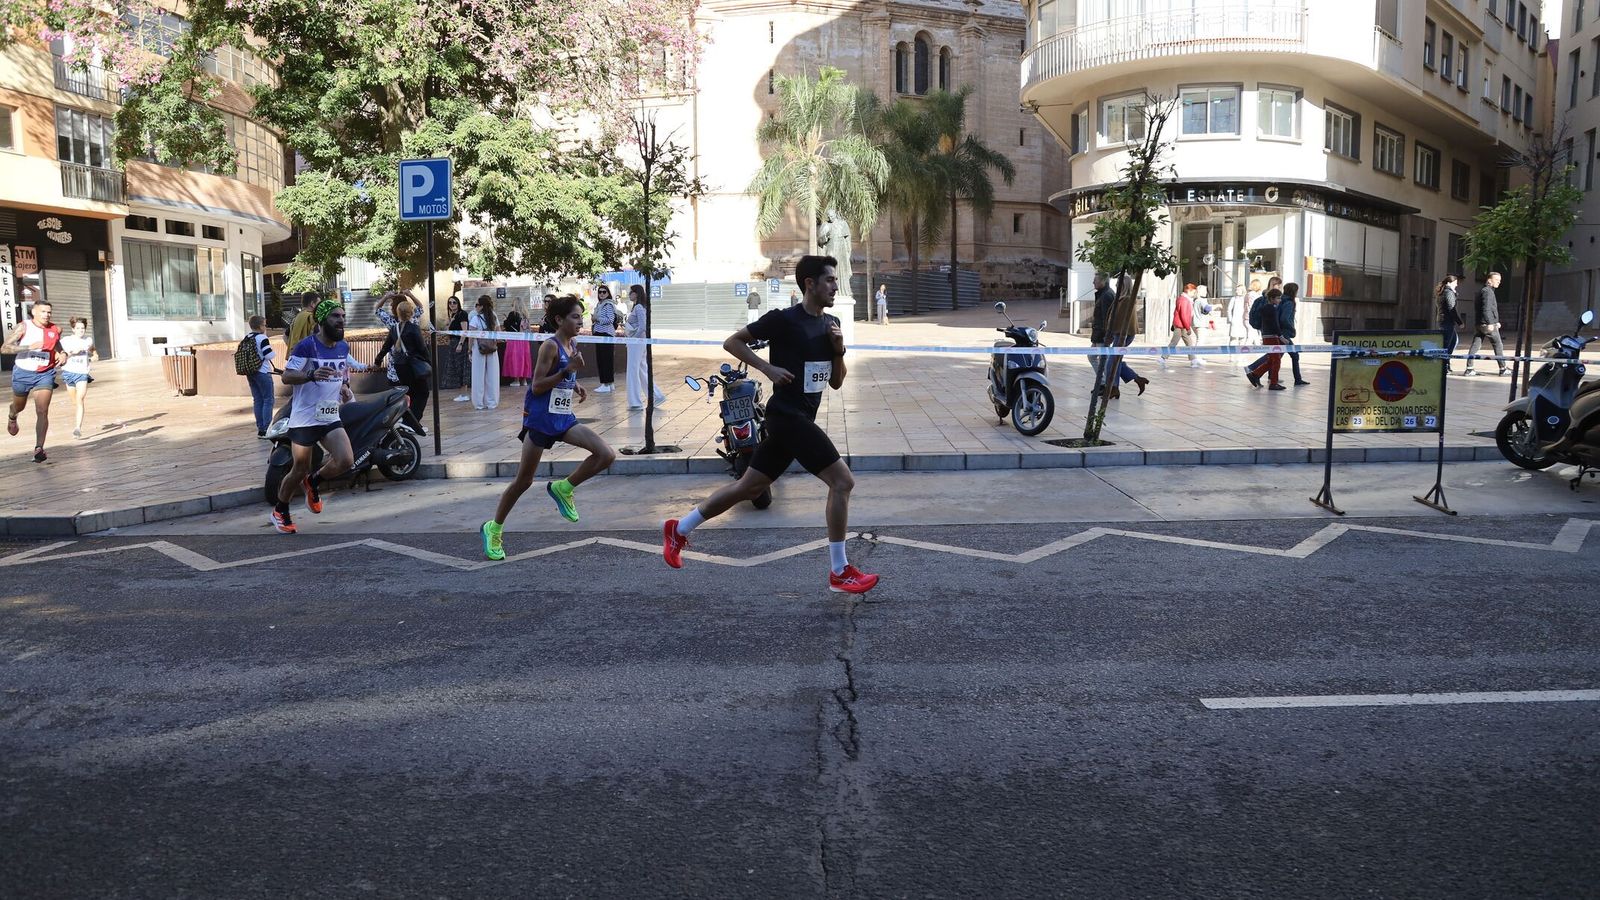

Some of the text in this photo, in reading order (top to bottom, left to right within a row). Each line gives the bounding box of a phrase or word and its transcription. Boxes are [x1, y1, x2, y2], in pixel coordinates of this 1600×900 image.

[402, 165, 434, 213] P
[1187, 189, 1245, 202] ESTATE
[418, 204, 447, 214] MOTOS
[14, 250, 36, 260] ATM
[1382, 340, 1413, 349] LOCAL
[812, 372, 829, 382] 992
[729, 399, 750, 411] 6492
[1373, 405, 1414, 415] ESTACIONAR
[1336, 417, 1349, 426] LAS
[1353, 417, 1362, 425] 23
[1375, 416, 1388, 426] DEL
